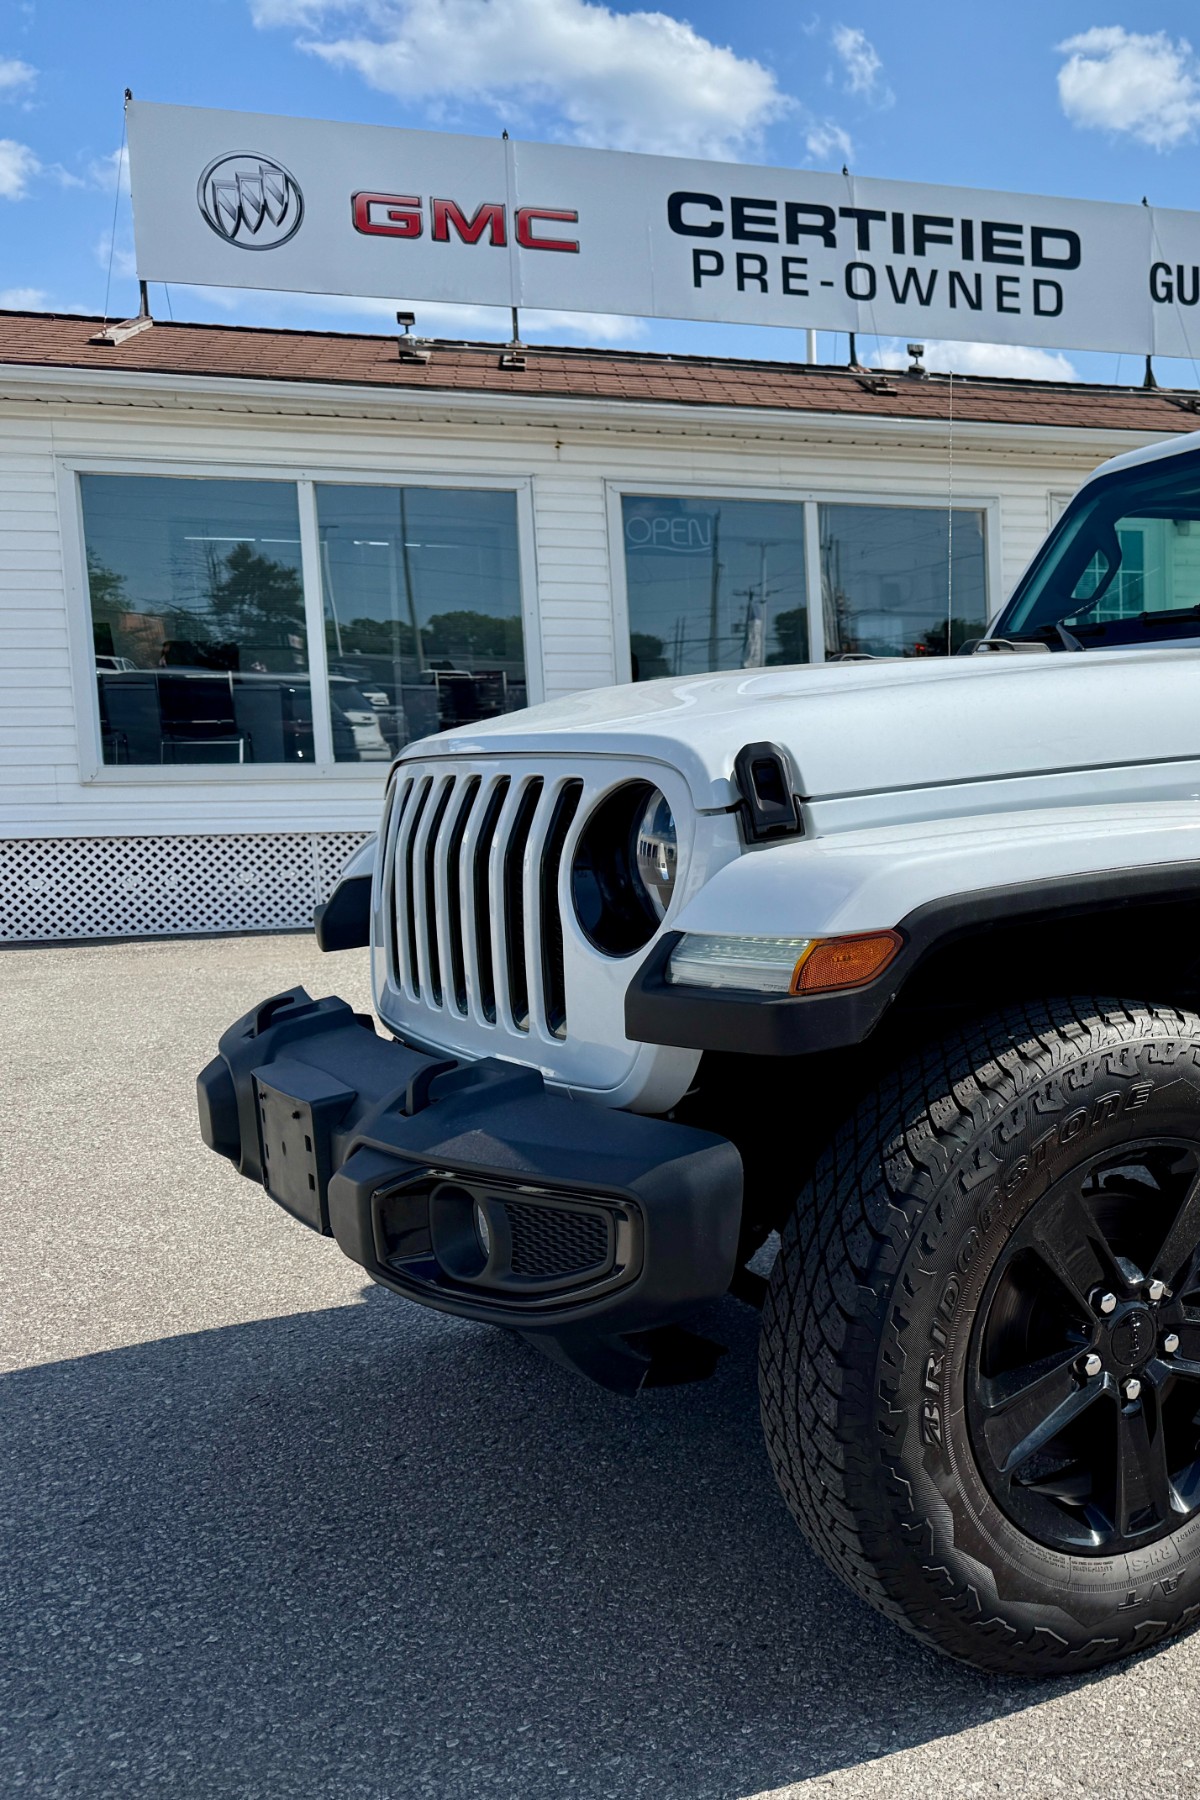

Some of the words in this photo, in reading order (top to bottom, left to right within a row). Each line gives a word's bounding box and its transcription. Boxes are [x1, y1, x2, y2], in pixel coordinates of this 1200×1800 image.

[350, 189, 580, 254] GMC
[667, 191, 1082, 271] CERTIFIED
[691, 248, 1064, 318] PRE-OWNED
[626, 516, 711, 546] OPEN
[921, 1079, 1154, 1450] BRIDGESTONE
